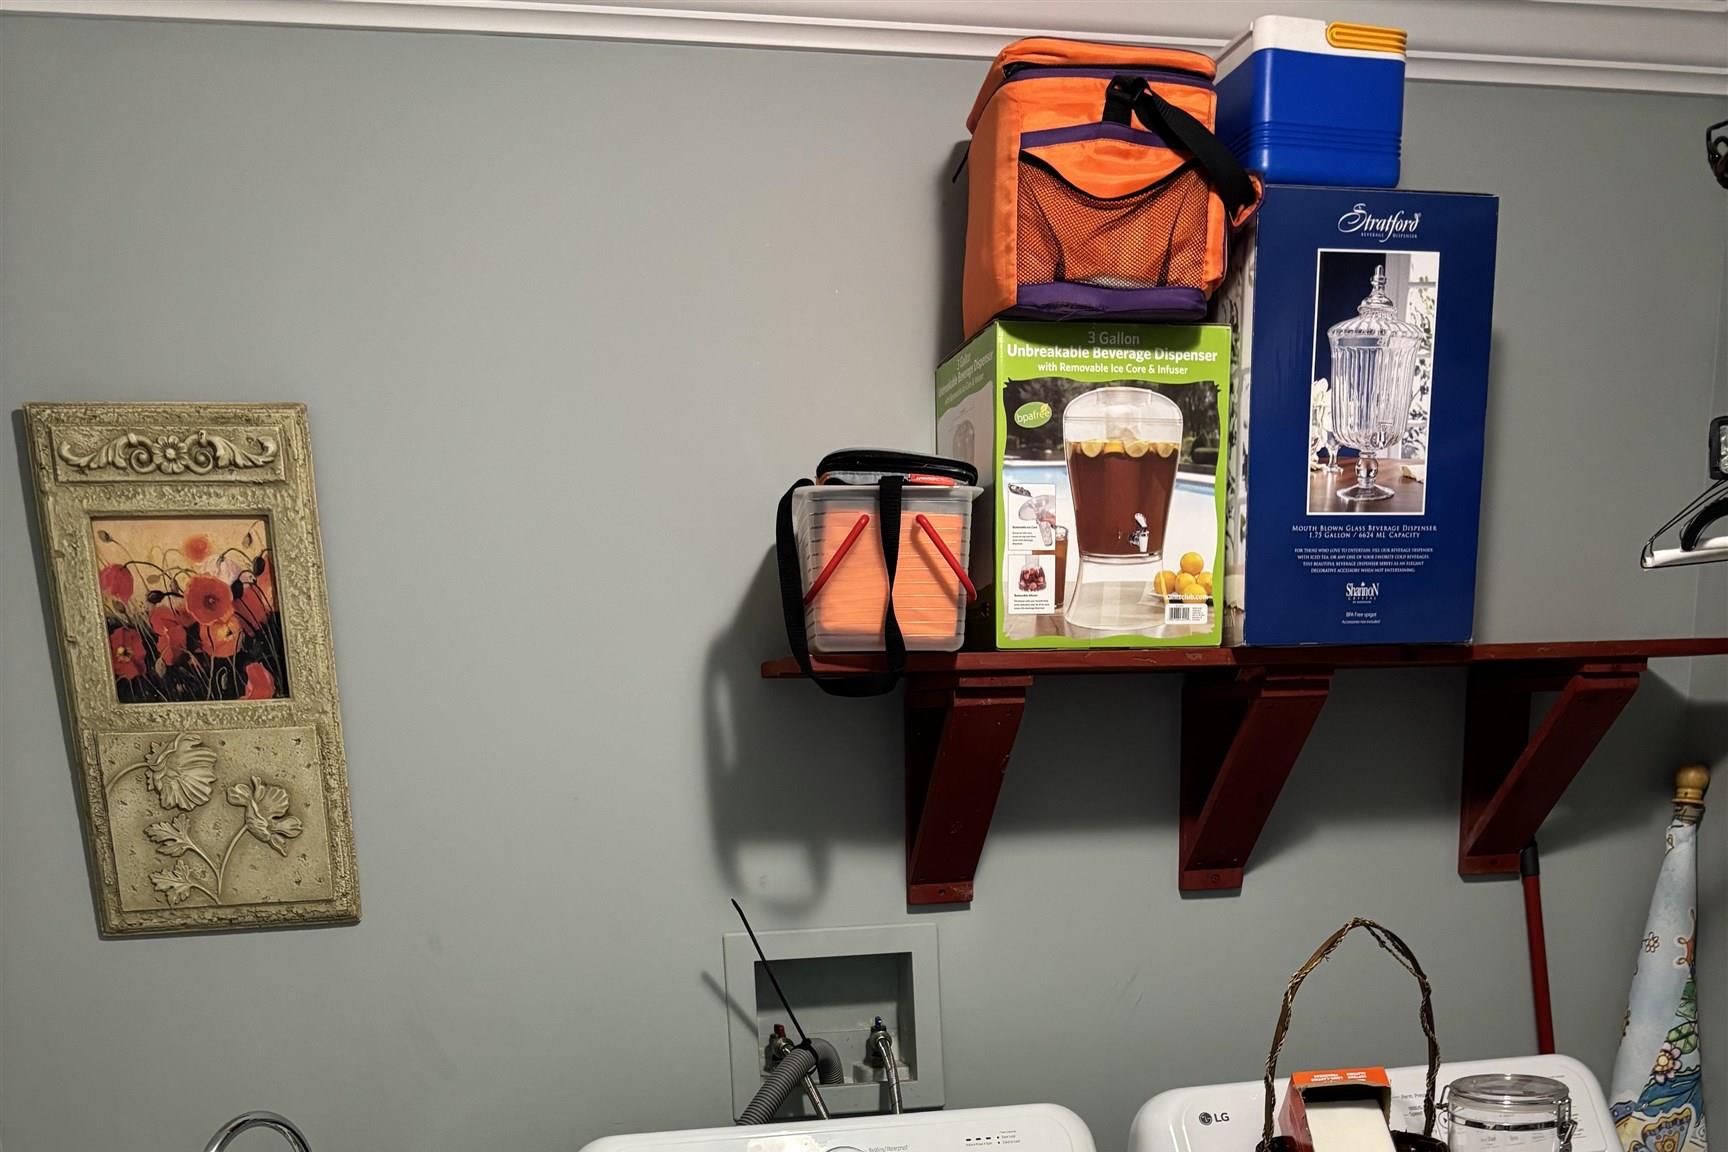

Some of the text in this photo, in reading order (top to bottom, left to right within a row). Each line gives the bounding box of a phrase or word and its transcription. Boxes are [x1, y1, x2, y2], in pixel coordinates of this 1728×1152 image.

[1337, 203, 1421, 243] Stratford
[1088, 331, 1140, 346] 3 Gallon
[1007, 343, 1218, 363] Unbreakable Beverage Dispenser
[1038, 362, 1188, 375] with Removable Ice Core & Infuser
[1015, 404, 1050, 424] bpafree
[1324, 531, 1351, 539] GALLON
[1388, 531, 1421, 539] CAPACITY
[1213, 1112, 1230, 1122] LG
